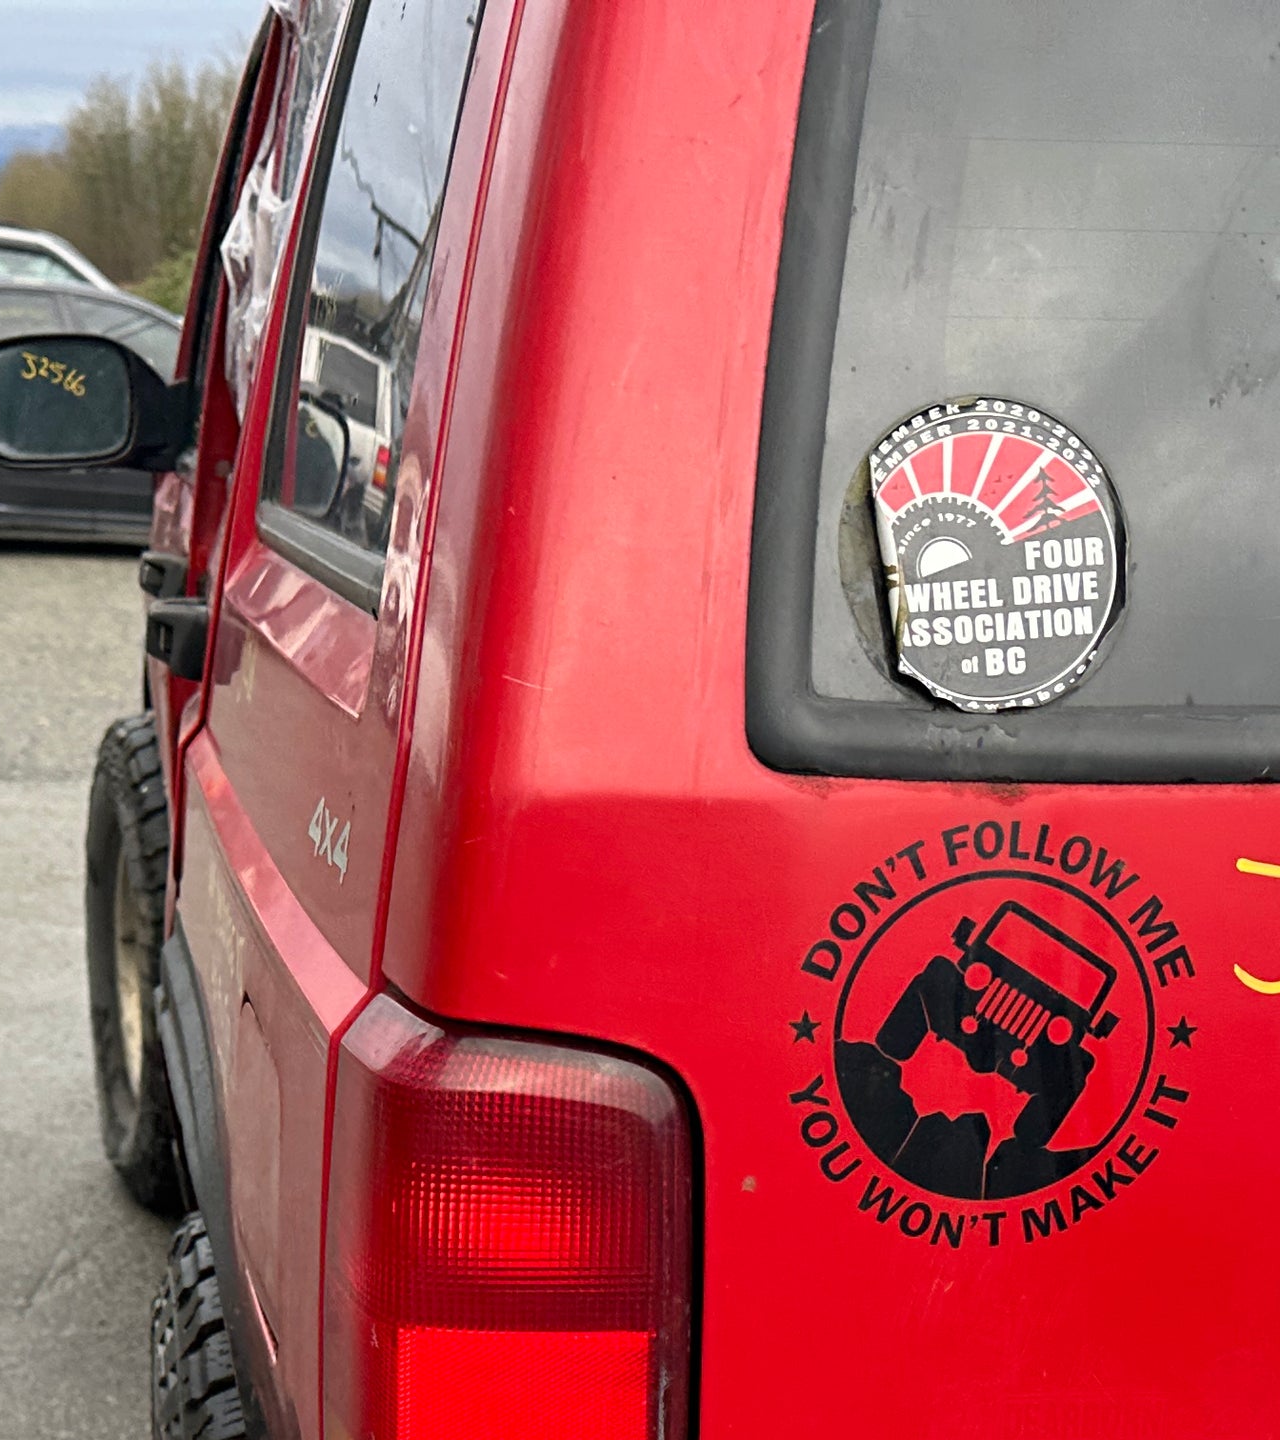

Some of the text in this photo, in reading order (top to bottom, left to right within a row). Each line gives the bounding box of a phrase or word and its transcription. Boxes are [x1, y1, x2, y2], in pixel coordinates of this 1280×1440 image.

[21, 351, 86, 396] J2566
[874, 419, 1100, 488] EMBER 2021-2022
[937, 513, 977, 528] 1977
[1024, 537, 1105, 571] FOUR
[904, 571, 1099, 613] WHEEL DRIVE
[961, 646, 1027, 676] of BC
[800, 820, 1197, 988] DON'T FOLLOW ME
[789, 1074, 1190, 1249] YOU WON'T MAKE IT
